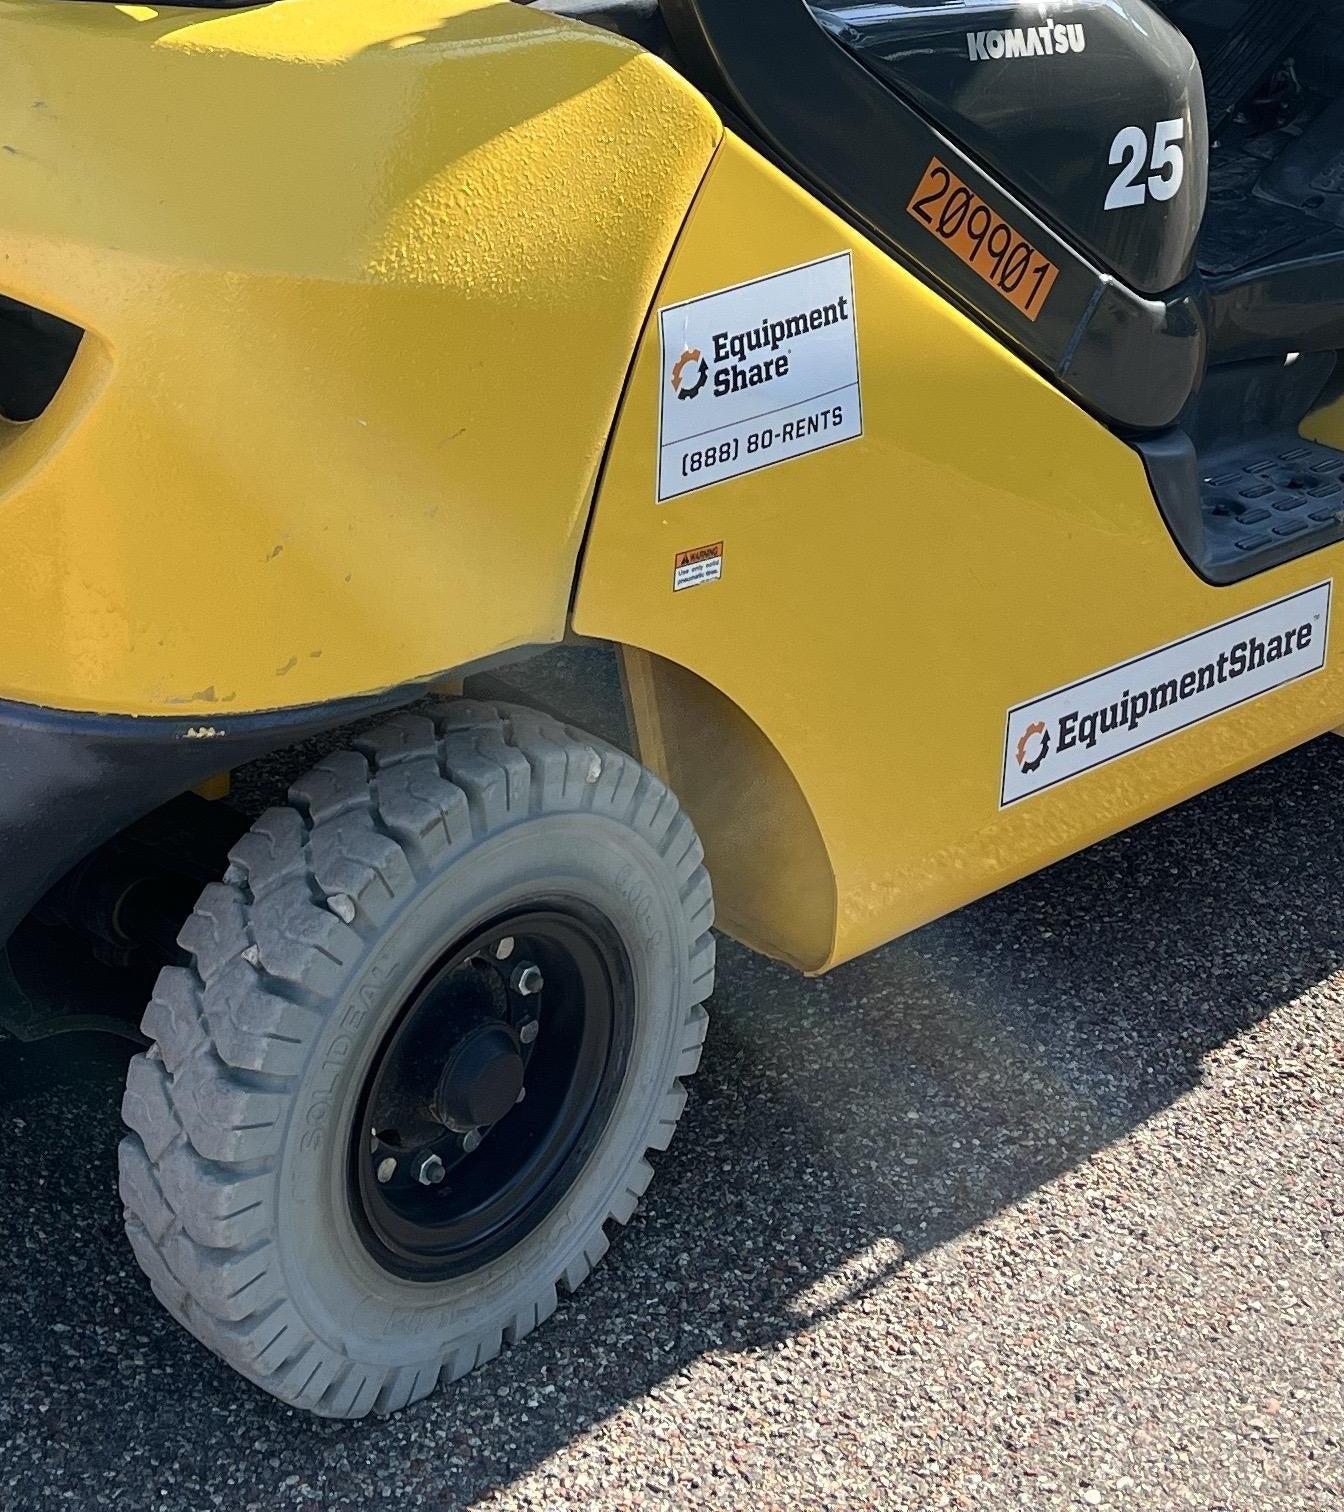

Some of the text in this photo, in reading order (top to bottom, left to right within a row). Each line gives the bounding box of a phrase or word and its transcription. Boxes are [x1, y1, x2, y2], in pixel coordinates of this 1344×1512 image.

[966, 19, 1085, 61] KOMATSU
[1104, 117, 1184, 211] 25
[913, 167, 1051, 309] 209901
[712, 295, 848, 364] Equipment
[713, 354, 789, 397] Share
[682, 406, 843, 476] (888) 80-RENTS
[1056, 622, 1312, 753] EquipmentShare
[298, 961, 401, 1154] SOLIDEAL
